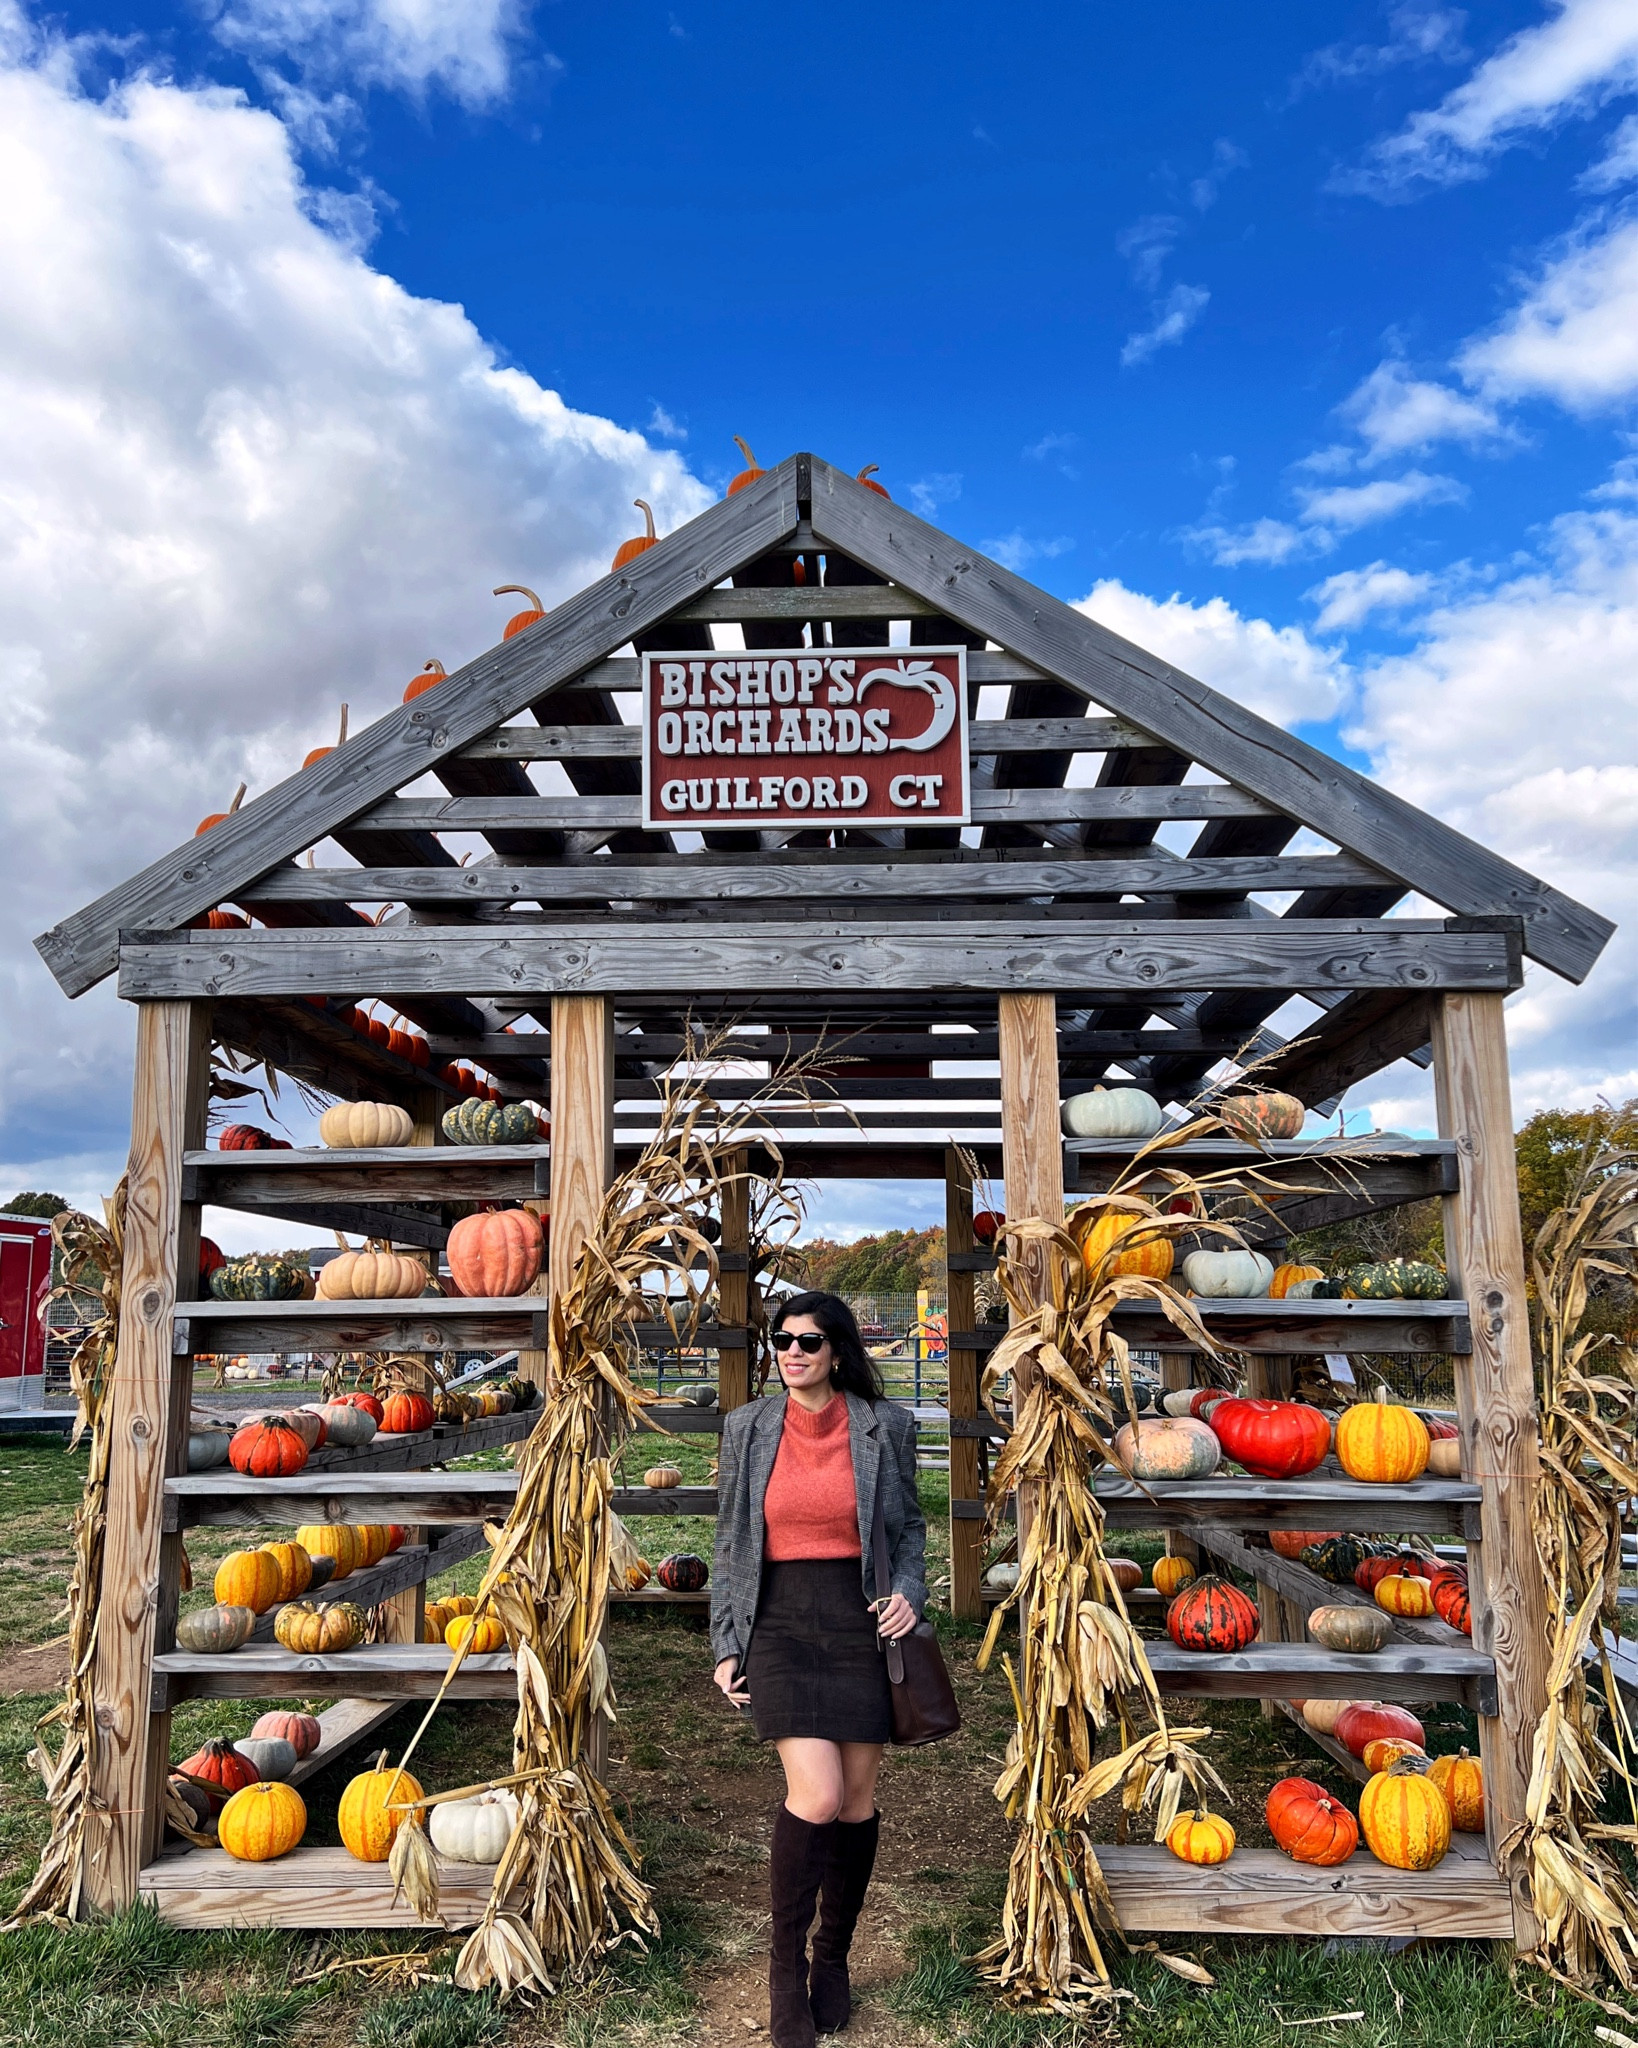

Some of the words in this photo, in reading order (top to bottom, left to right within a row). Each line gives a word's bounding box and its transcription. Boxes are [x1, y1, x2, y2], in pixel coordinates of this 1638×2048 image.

[659, 658, 856, 707] BISHOP'S
[658, 708, 890, 756] ORCHARDS
[660, 776, 868, 812] GUILFORD
[888, 774, 943, 808] CT
